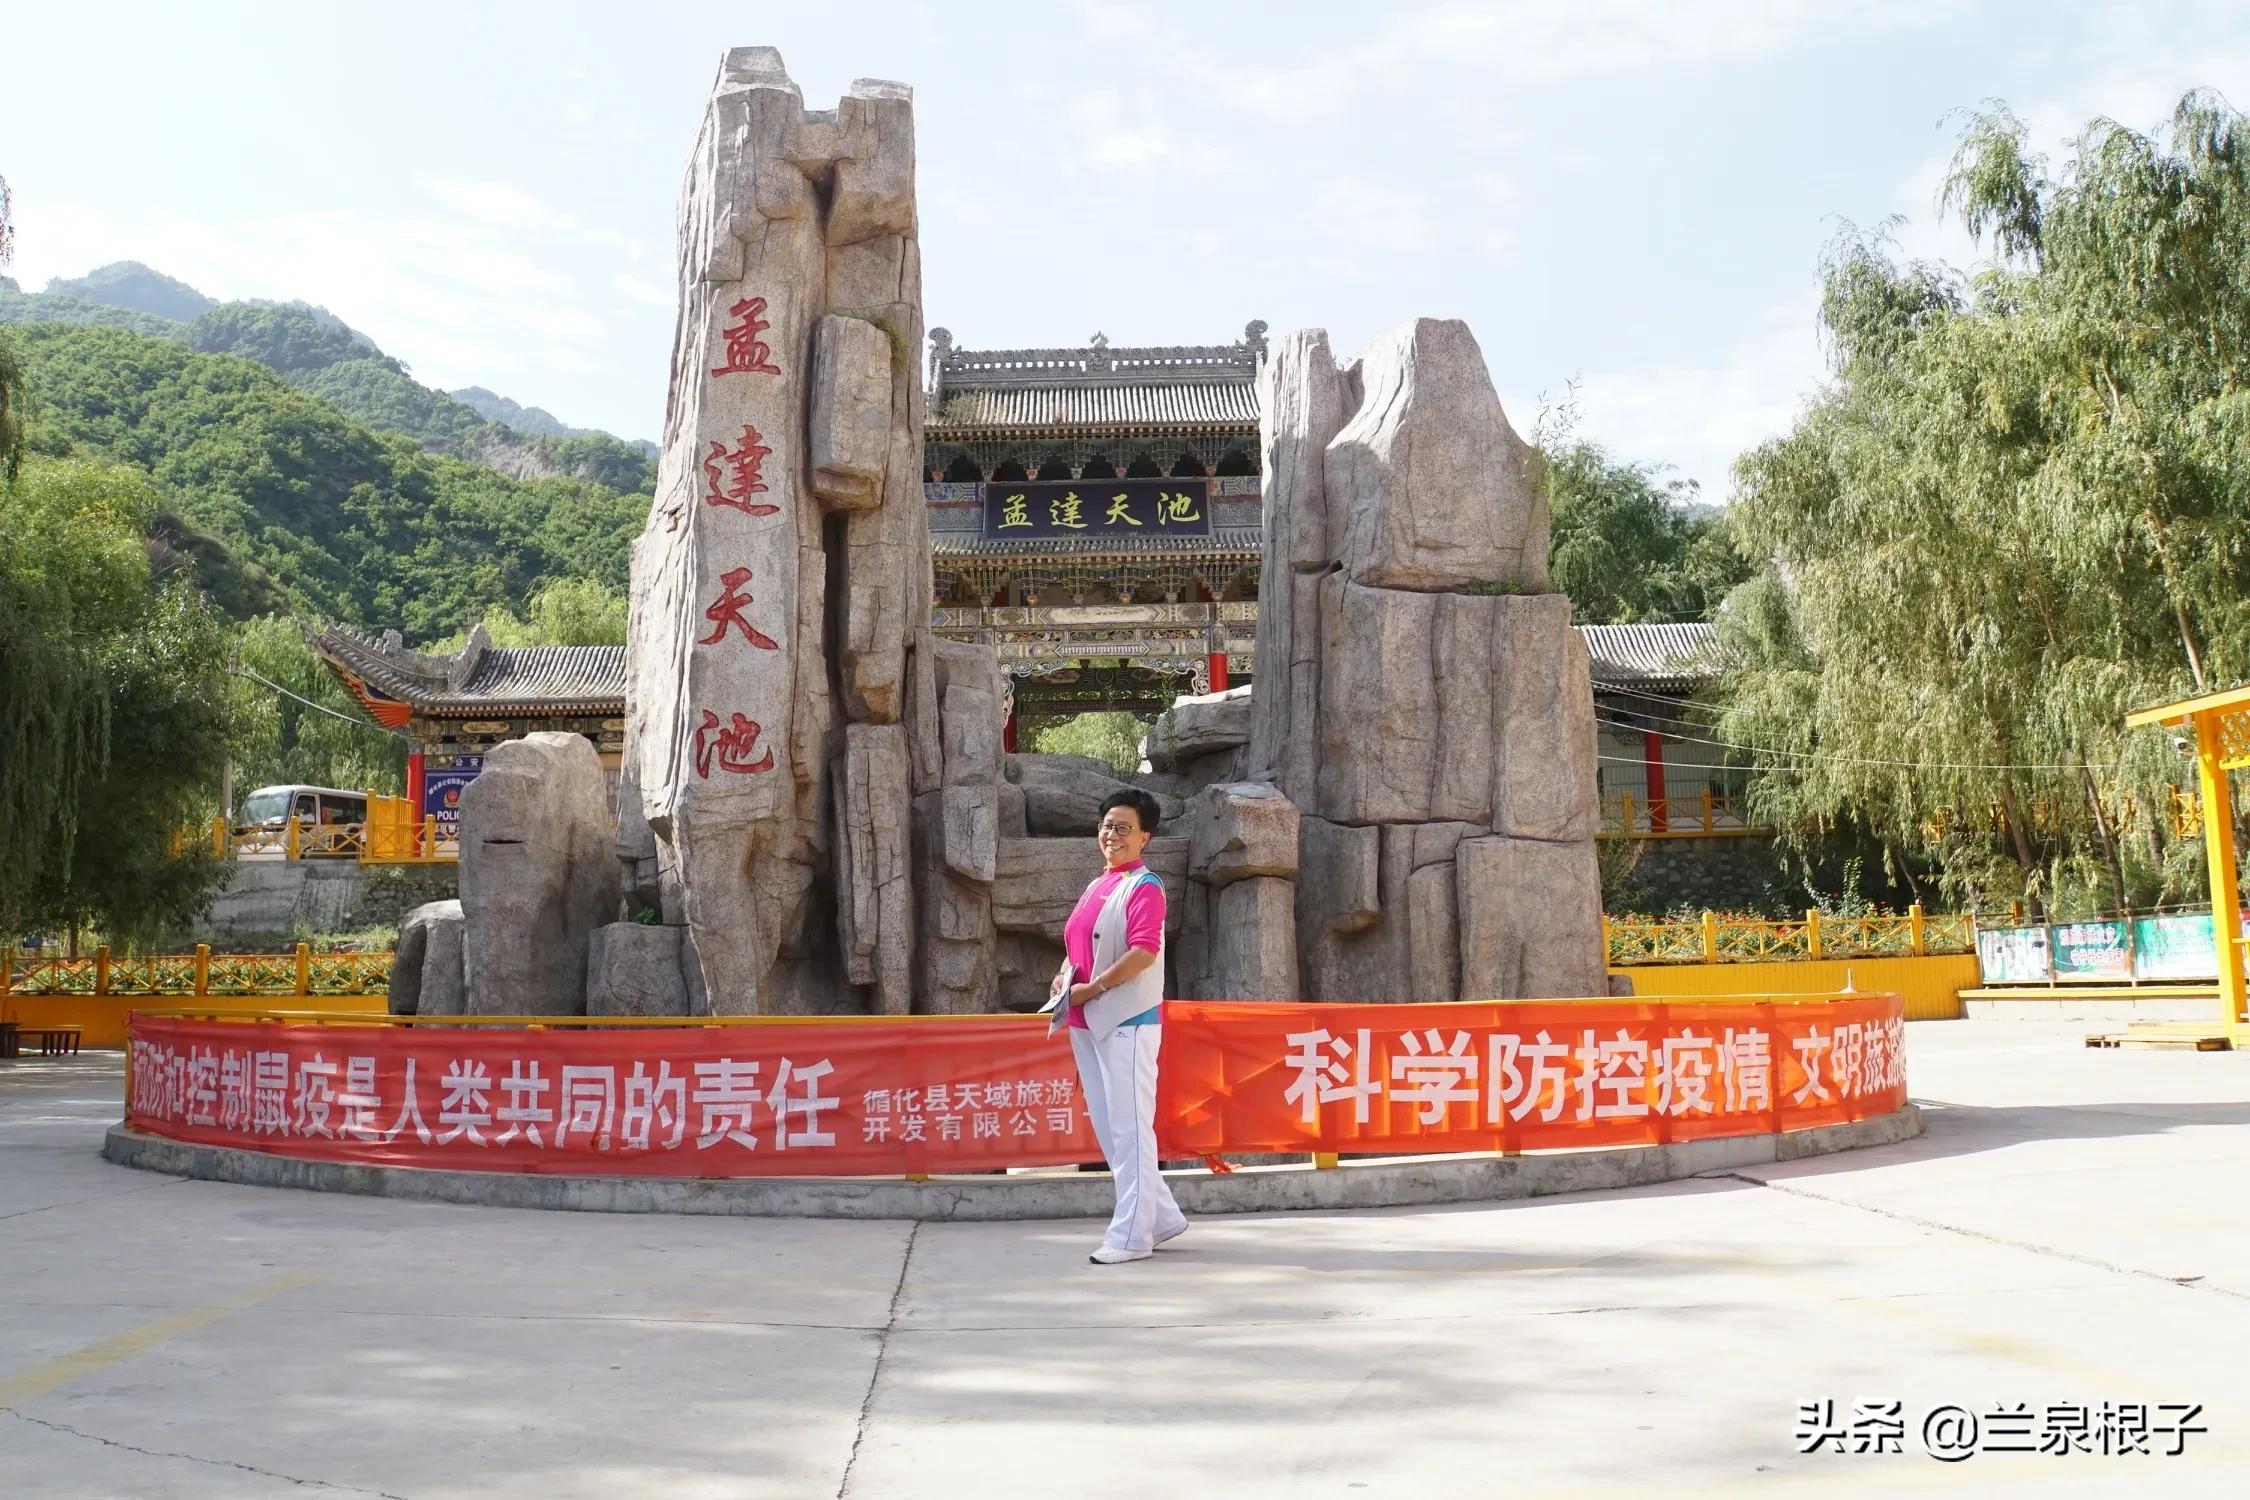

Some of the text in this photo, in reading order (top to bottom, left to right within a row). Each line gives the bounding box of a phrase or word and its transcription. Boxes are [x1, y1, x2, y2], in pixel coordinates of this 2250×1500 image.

[1284, 1027, 1771, 1126] 科学防控疫情
[863, 1078, 1074, 1114] 循化县天域旅游
[863, 1107, 1074, 1143] 开发有限公司
